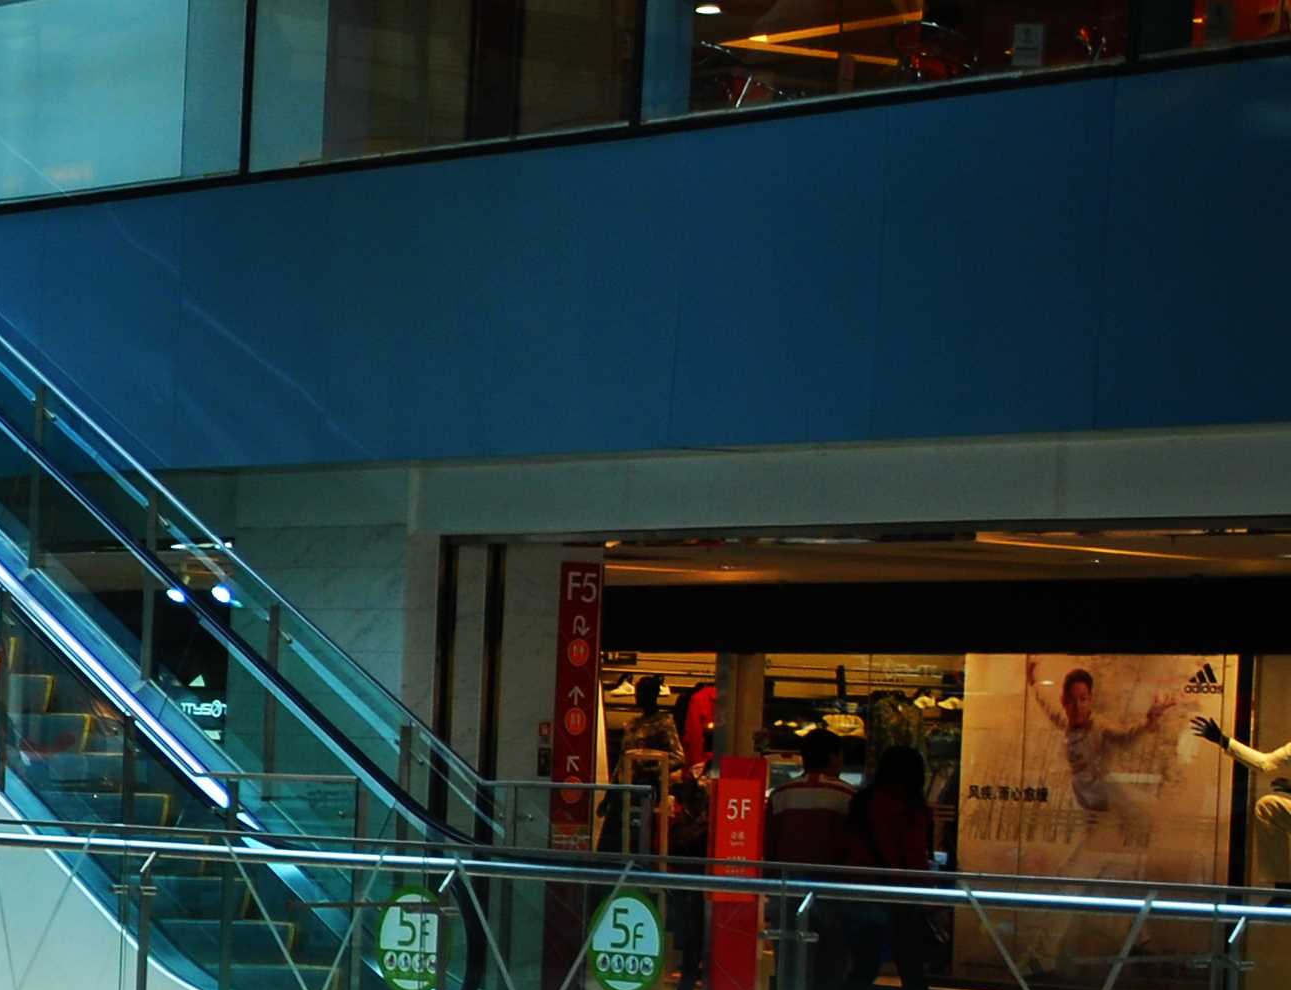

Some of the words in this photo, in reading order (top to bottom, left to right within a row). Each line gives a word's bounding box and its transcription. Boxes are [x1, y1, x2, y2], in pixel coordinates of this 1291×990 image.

[567, 572, 597, 603] F5
[1184, 683, 1223, 695] adidas
[726, 799, 751, 819] 5F
